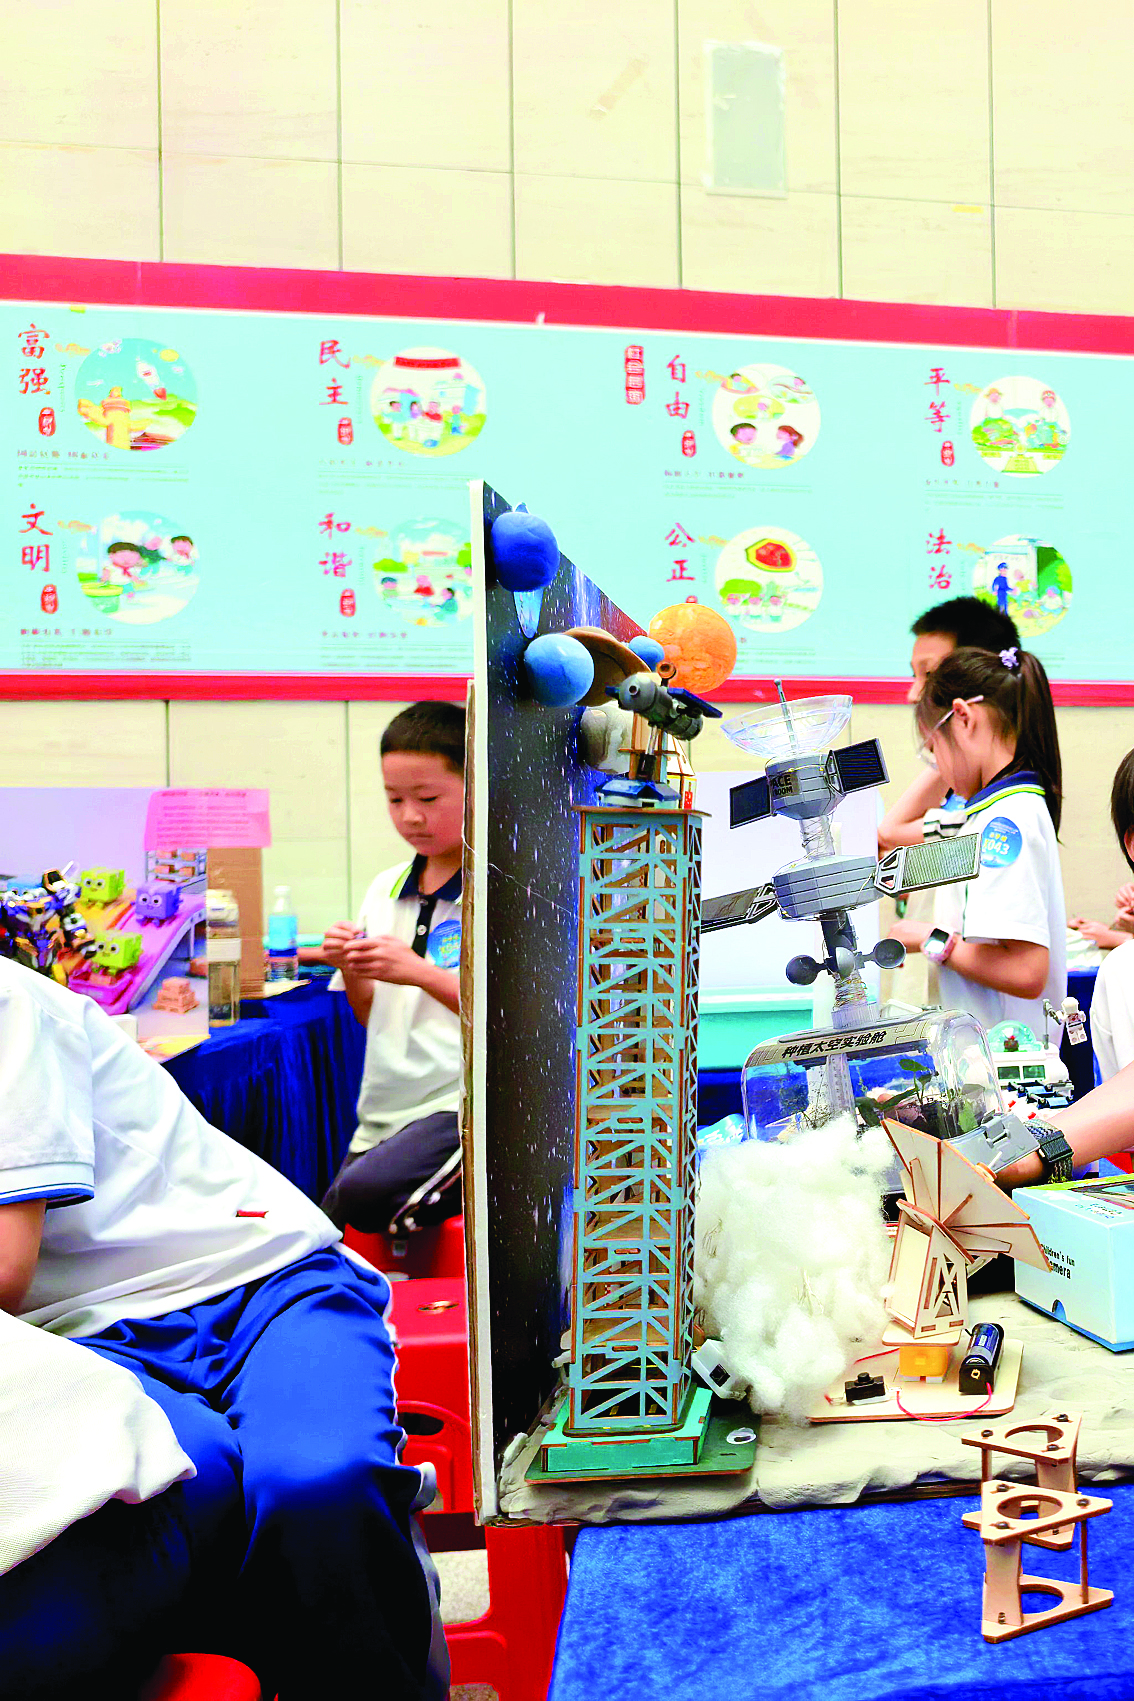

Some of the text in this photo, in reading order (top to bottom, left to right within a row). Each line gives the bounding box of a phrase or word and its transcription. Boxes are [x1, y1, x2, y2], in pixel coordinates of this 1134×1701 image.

[18, 322, 51, 395] 富强
[319, 339, 351, 406] 民主
[665, 354, 690, 419] 自由
[924, 367, 951, 433] 平等
[19, 503, 53, 573] 文明
[318, 512, 352, 578] 和谐
[665, 522, 696, 582] 公正
[926, 528, 952, 589] 法治
[781, 1030, 887, 1059] 种植太空实验舱
[1045, 1256, 1071, 1280] amera
